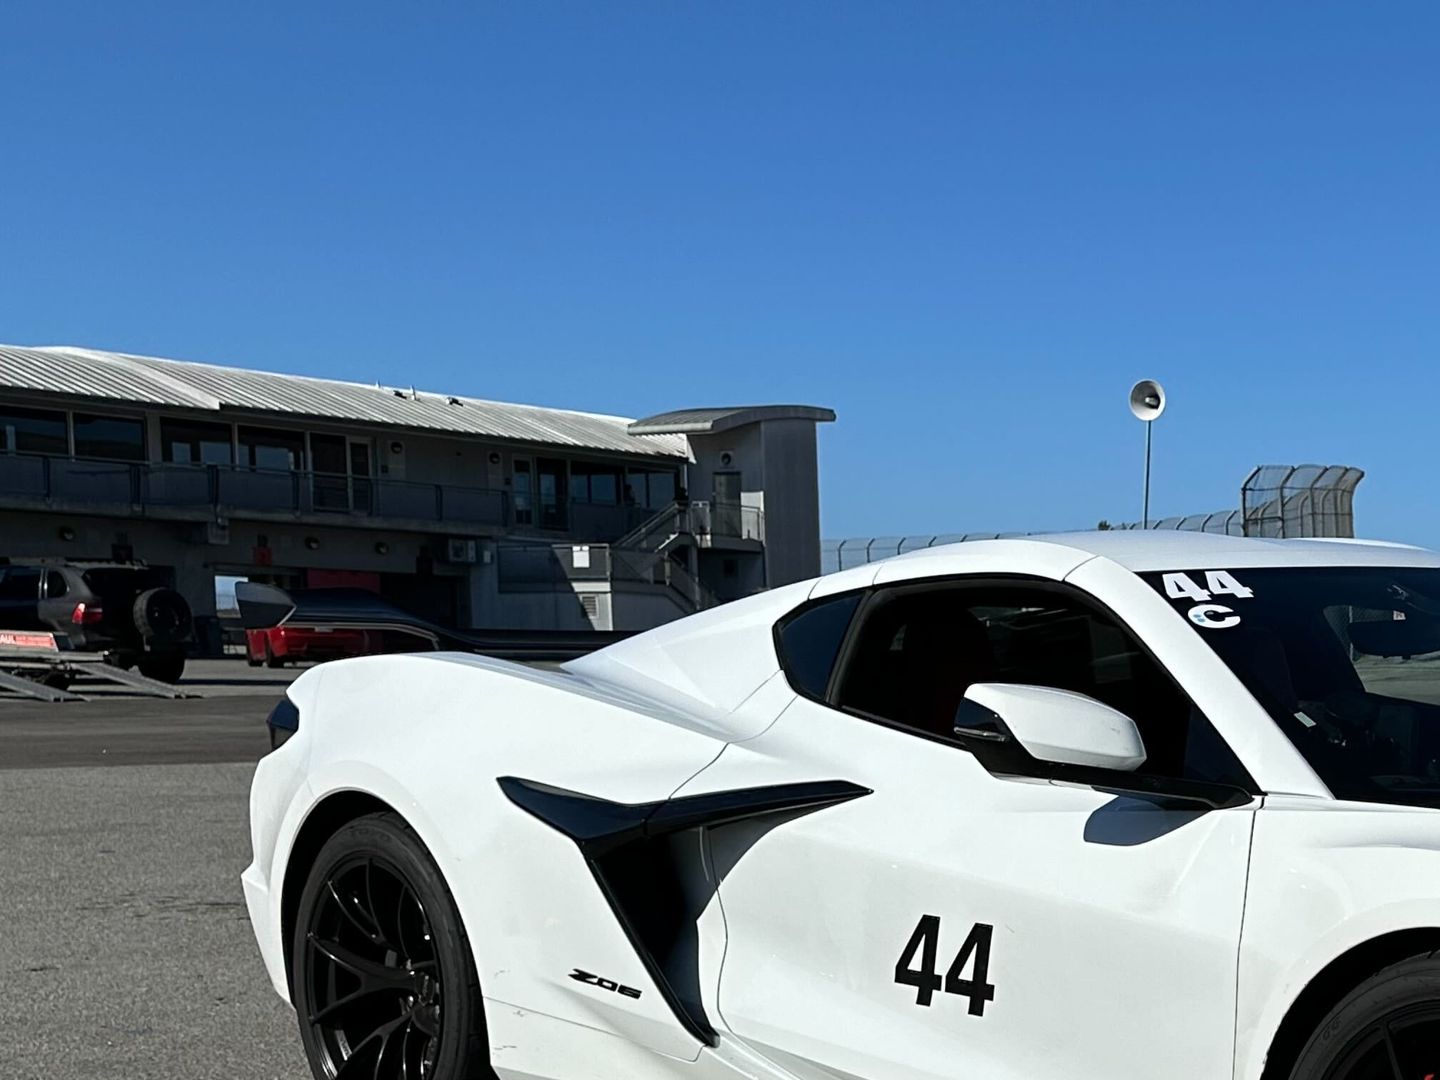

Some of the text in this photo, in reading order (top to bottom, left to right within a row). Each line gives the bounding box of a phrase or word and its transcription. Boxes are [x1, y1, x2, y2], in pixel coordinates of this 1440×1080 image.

[1162, 570, 1254, 602] 44
[1188, 604, 1241, 628] C
[894, 914, 995, 1017] 44
[568, 967, 643, 999] Z06
